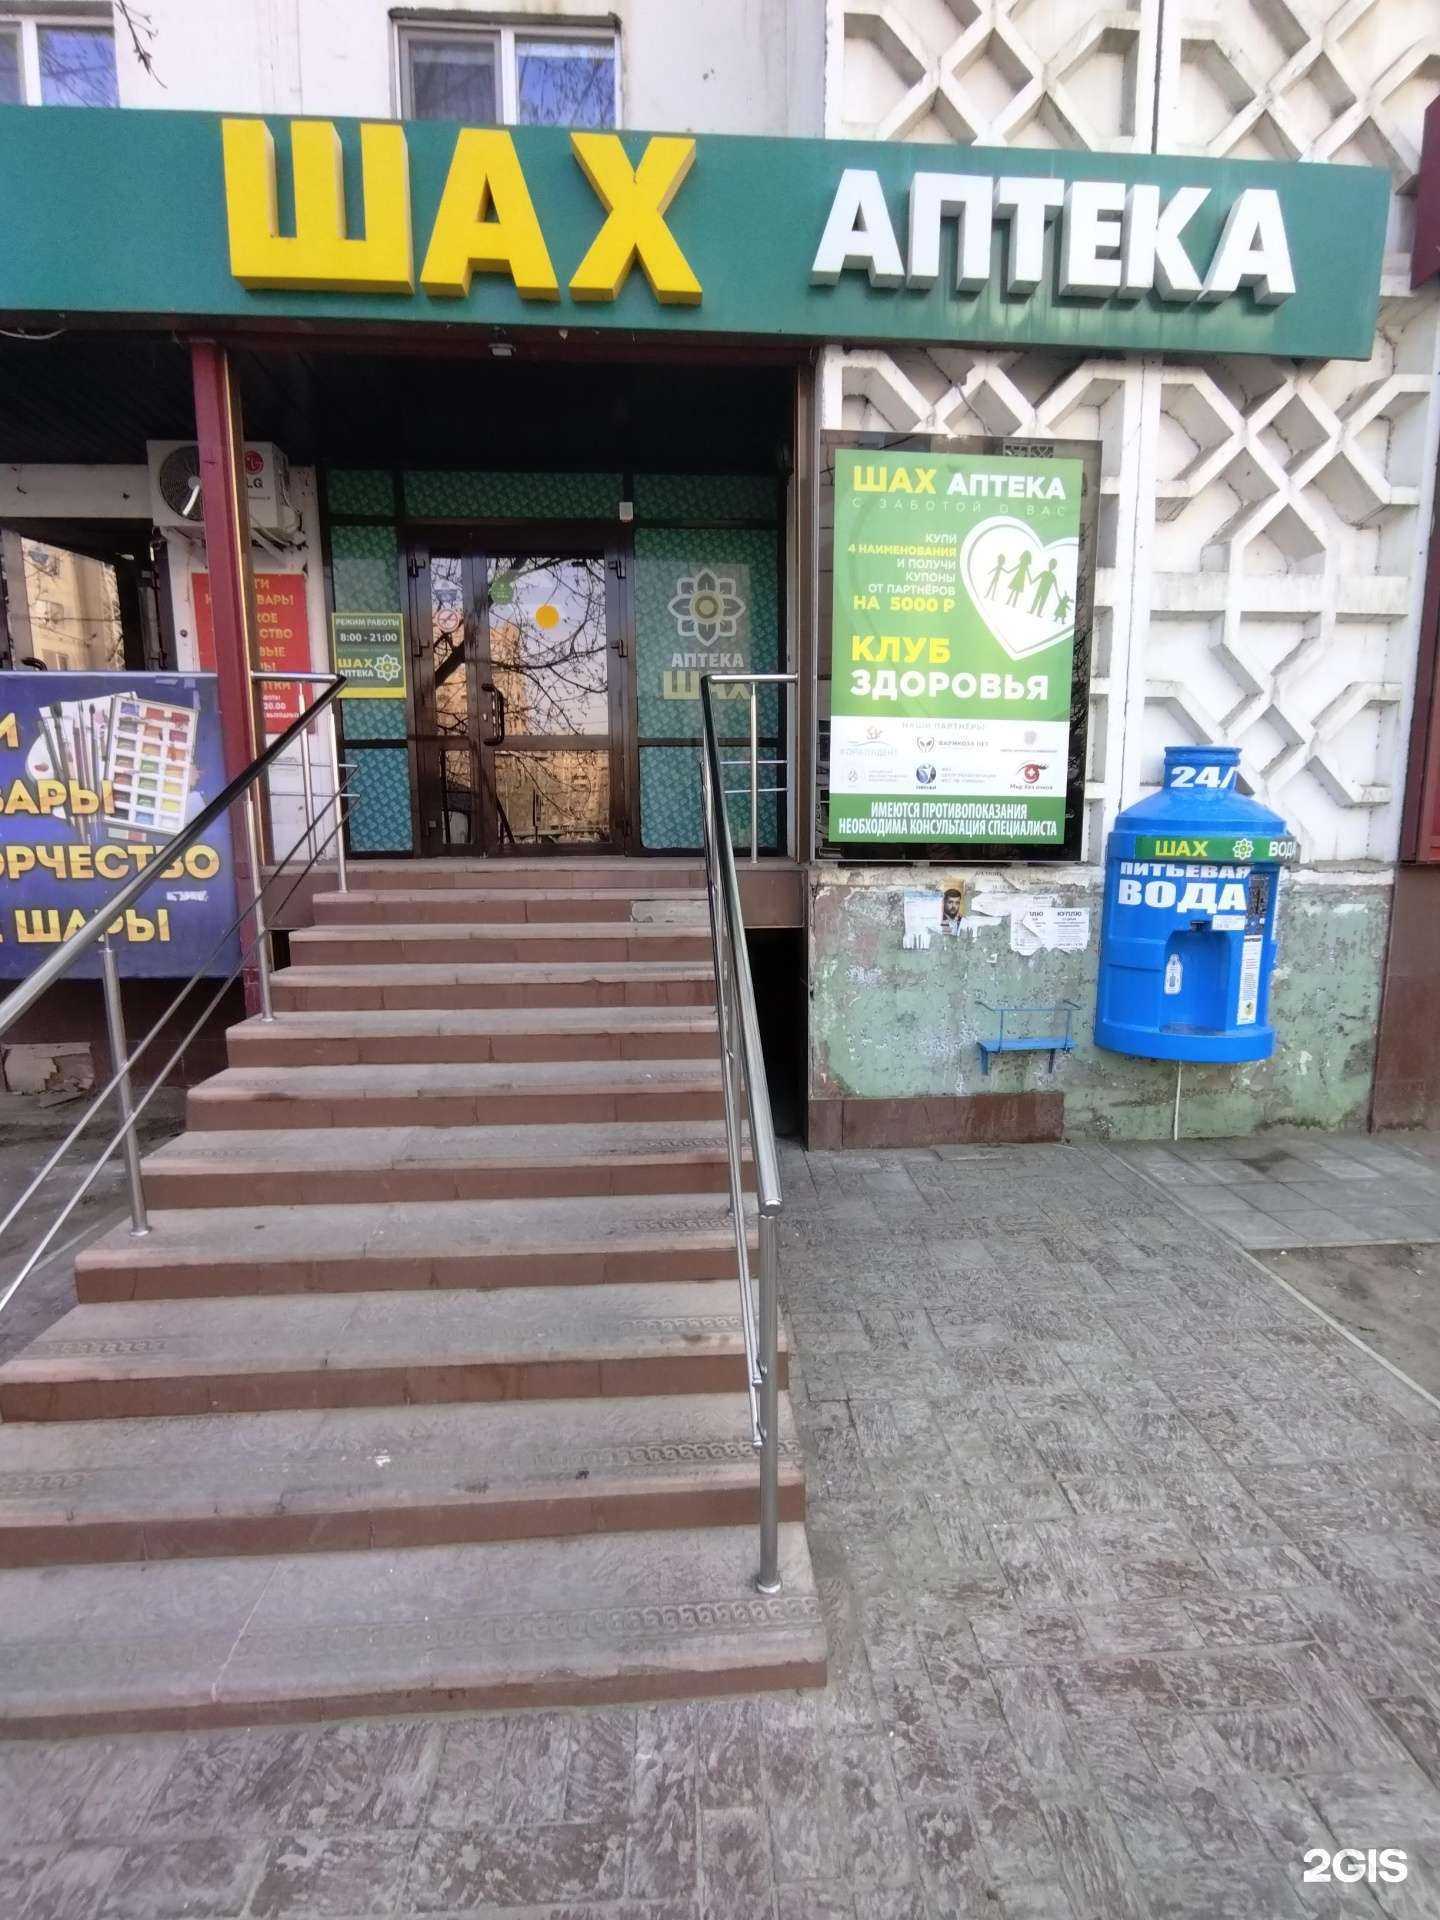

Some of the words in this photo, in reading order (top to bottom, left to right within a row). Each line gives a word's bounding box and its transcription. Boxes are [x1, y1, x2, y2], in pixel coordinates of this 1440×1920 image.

[221, 118, 702, 303] ШАХ
[810, 168, 1297, 304] АПТЕКА
[853, 465, 937, 495] ШАХ
[946, 472, 1066, 500] АПТЕКА
[1026, 506, 1066, 517] ВАС
[925, 533, 957, 544] КУПИ
[848, 544, 856, 554] 4
[858, 544, 957, 557] НАИМЕНОВАНИЯ
[897, 559, 905, 568] И
[908, 559, 956, 570] ПОЛУЧИ
[905, 572, 956, 583] КУПОНЫ
[868, 584, 884, 593] ОТ
[853, 595, 880, 610] НА
[890, 596, 938, 612] 5000
[335, 618, 365, 626] РЕЖИМ
[367, 618, 400, 626] РАБОТЫ
[340, 632, 362, 642] 8:00
[369, 632, 398, 642] 21:00
[851, 635, 951, 664] КЛУБ
[337, 658, 373, 668] ШАХ
[671, 652, 744, 668] АПТЕКА
[340, 669, 374, 678] АПТЕКА
[850, 668, 1049, 701] ЗДОРОВЬЯ
[0, 779, 115, 815] АРЫ
[871, 801, 920, 818] ИМЕЮТСЯ
[923, 804, 1027, 820] ПРОТИВОПОКАЗАНИЯ
[839, 818, 908, 836] НЕОБХОДИМА
[910, 820, 986, 838] КОНСУЛЬТАЦИЯ
[988, 820, 1057, 838] СПЕЦИАЛИСТА
[1155, 840, 1208, 857] ШАХ
[0, 845, 220, 879] РЧЕСТО
[1120, 862, 1251, 879] ПИТЬЕВАЯ
[1118, 879, 1247, 913] ВОДА
